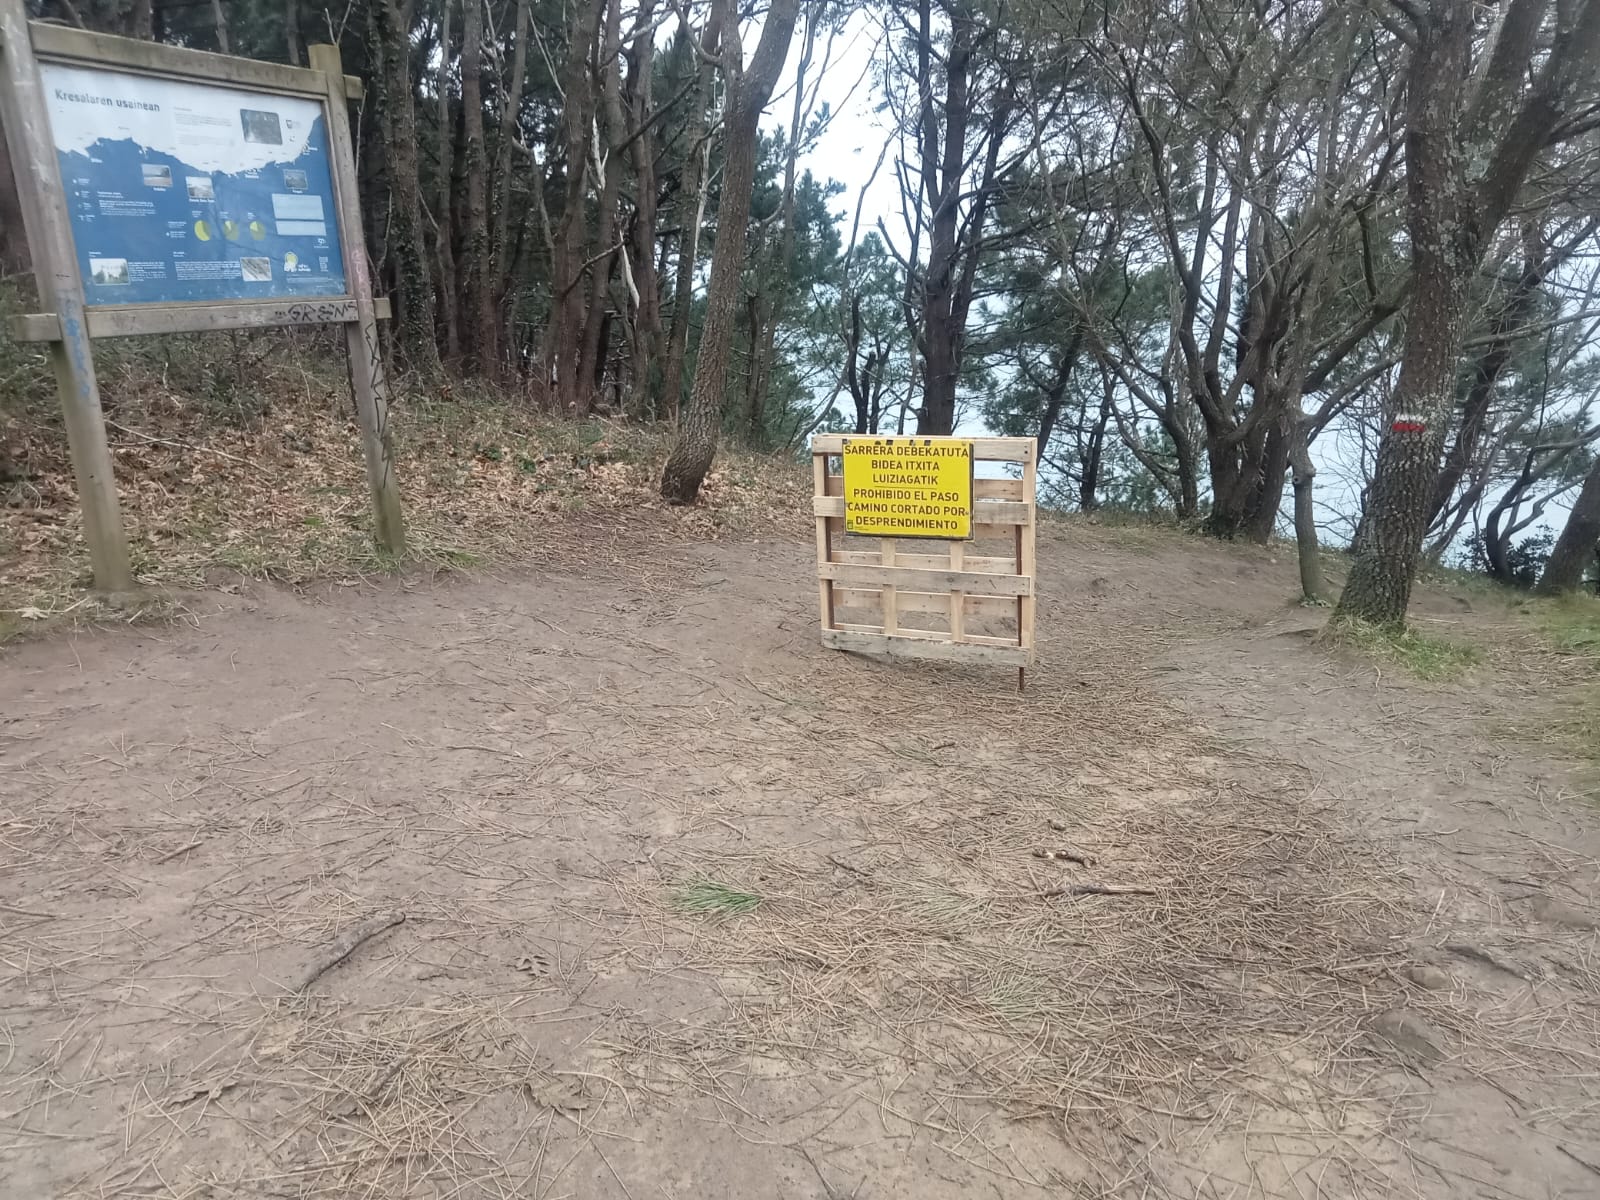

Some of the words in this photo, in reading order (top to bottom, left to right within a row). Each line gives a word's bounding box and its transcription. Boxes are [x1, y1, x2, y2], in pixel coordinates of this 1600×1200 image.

[55, 88, 113, 107] Kresalaren
[116, 99, 160, 112] usainean
[845, 445, 894, 456] SARRERA
[896, 446, 969, 458] DEBEKATUTA
[871, 459, 903, 470] BIDEA
[905, 460, 940, 471] ITXITA
[872, 473, 939, 485] LUIZIAGATIK
[853, 488, 911, 500] PROHIBIDO
[914, 490, 927, 501] EL
[930, 491, 959, 502] PASO
[847, 502, 888, 513] CAMINO
[890, 504, 940, 515] CORTADO
[943, 506, 965, 516] POR
[855, 515, 958, 530] DESPRENDIMIENTO
